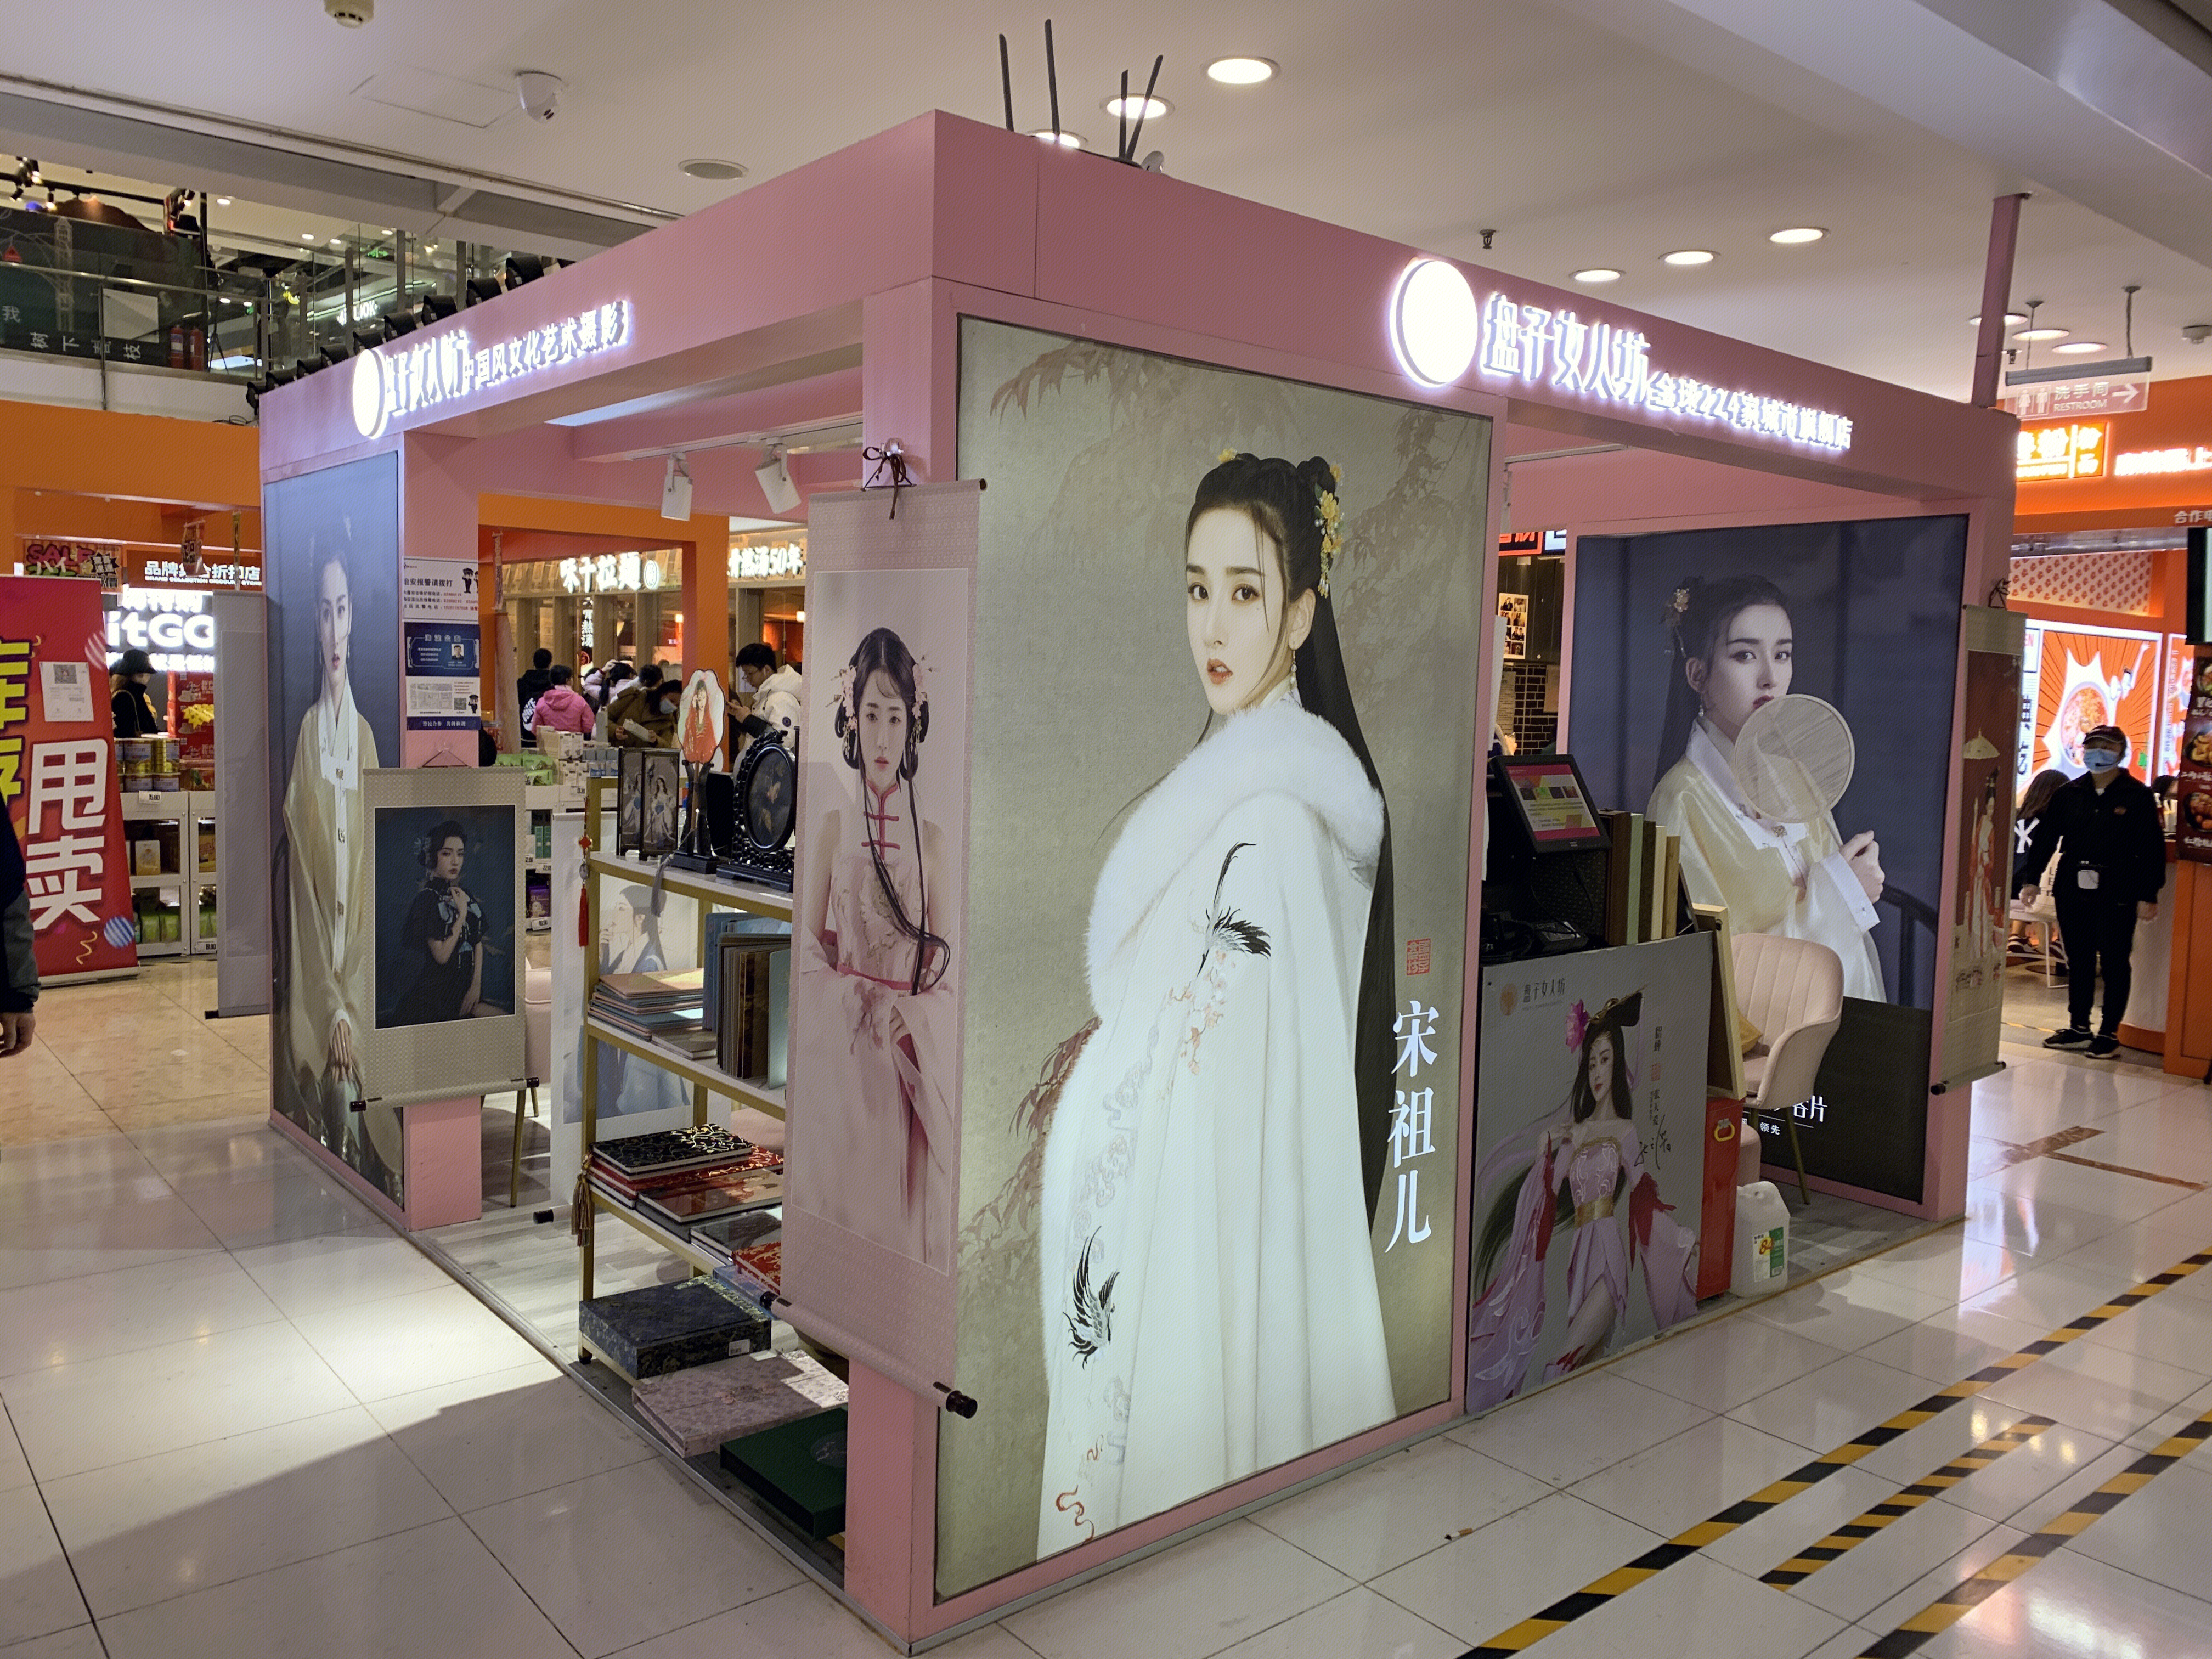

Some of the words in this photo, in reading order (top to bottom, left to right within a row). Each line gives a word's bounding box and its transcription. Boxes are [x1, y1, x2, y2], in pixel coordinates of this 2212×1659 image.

[463, 300, 630, 388] 中国风文化艺术摄影
[1481, 292, 1652, 404] 盘子女人坊
[1647, 371, 1854, 451] 全球224家城市旗舰店
[2053, 399, 2107, 412] RESTROOM
[2055, 381, 2109, 401] 洗手间
[726, 543, 803, 579] 骨熬汤50年
[26, 738, 109, 931] 甩卖
[1523, 977, 1566, 1003] 盘子女人坊
[1385, 999, 1440, 1254] 宋祖儿
[1759, 1238, 1774, 1255] 84
